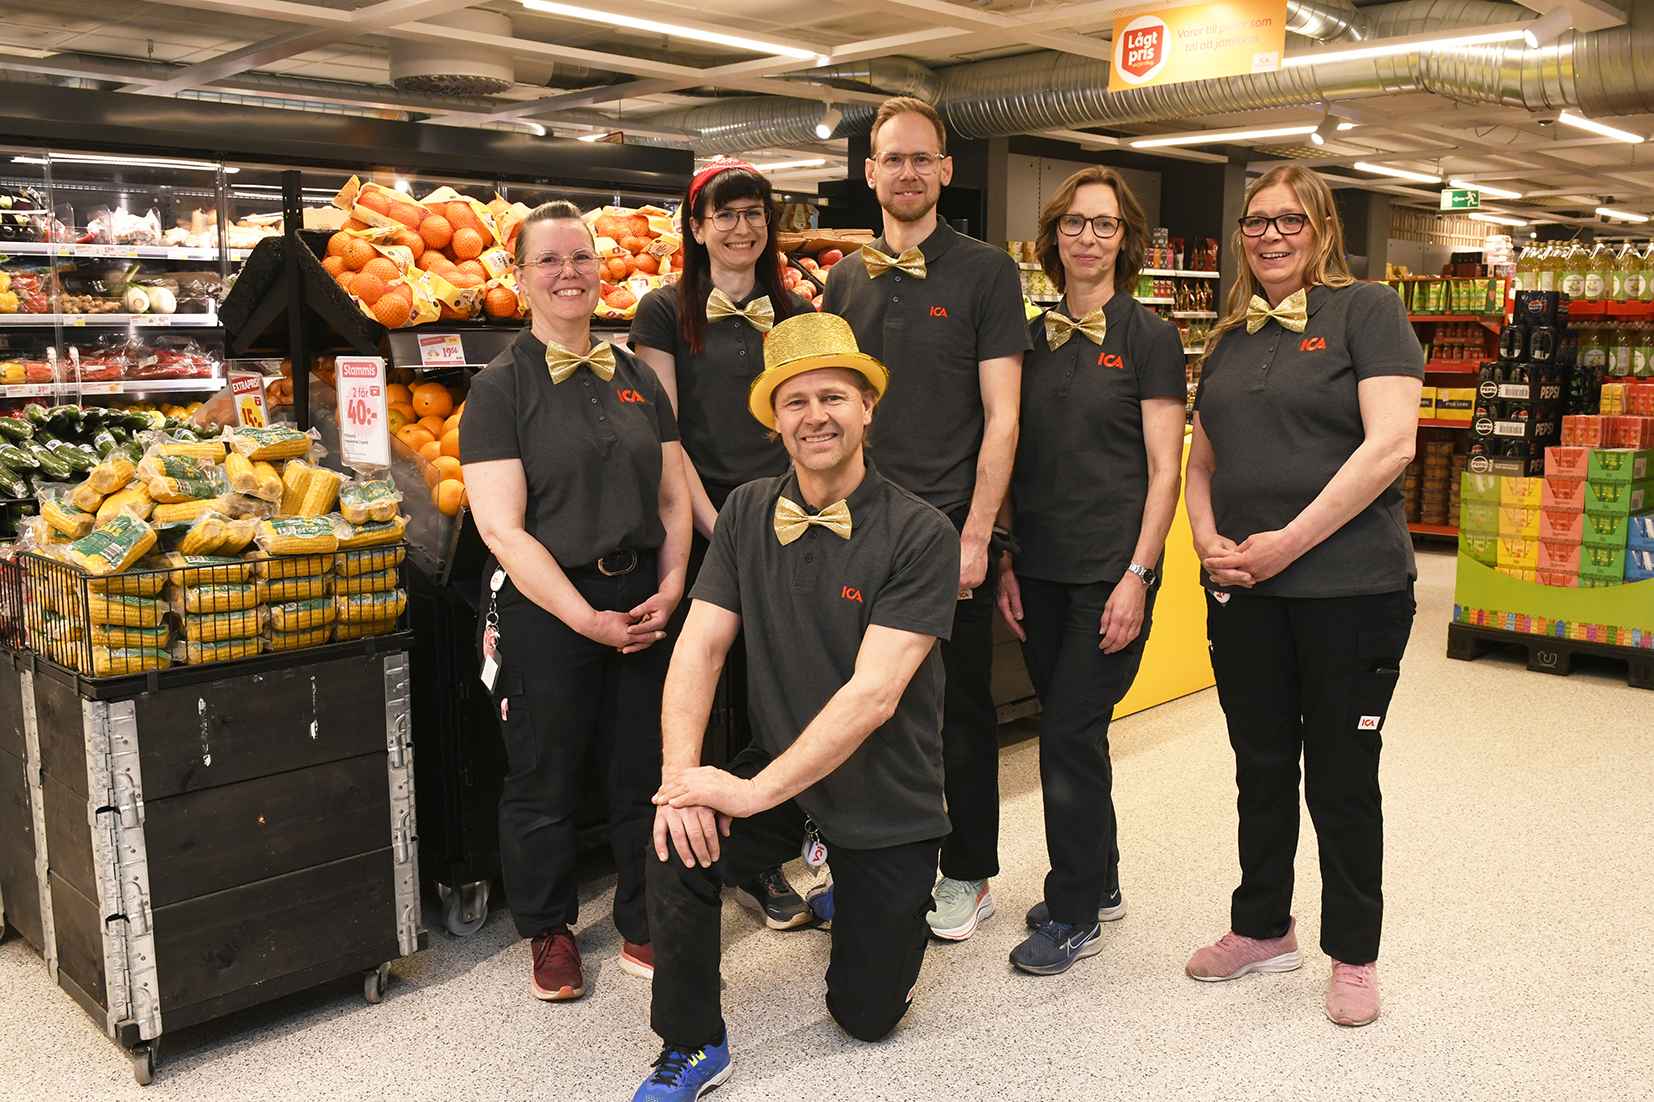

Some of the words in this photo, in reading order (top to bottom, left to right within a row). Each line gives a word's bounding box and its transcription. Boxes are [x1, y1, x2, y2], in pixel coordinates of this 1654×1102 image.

[1177, 27, 1204, 38] Varor
[1206, 24, 1217, 35] till
[1219, 21, 1248, 35] priser
[1250, 18, 1272, 28] som
[1128, 31, 1158, 49] Lågt
[1185, 40, 1198, 52] tål
[1200, 40, 1214, 50] att
[1214, 34, 1260, 51] jämföras
[1128, 46, 1155, 66] pris
[930, 306, 948, 318] ICA
[1299, 337, 1327, 352] ICA
[1097, 352, 1124, 369] ICA
[343, 364, 376, 376] Stammis
[352, 387, 357, 398] 2
[358, 387, 369, 398] för
[616, 389, 646, 403] ICA
[1540, 386, 1560, 399] PEPSI
[347, 399, 378, 425] 40:-
[1534, 421, 1555, 437] PEPSI
[1530, 459, 1544, 473] PEP
[841, 585, 864, 603] ICA
[1361, 719, 1375, 727] ICA
[812, 845, 826, 863] ICA
